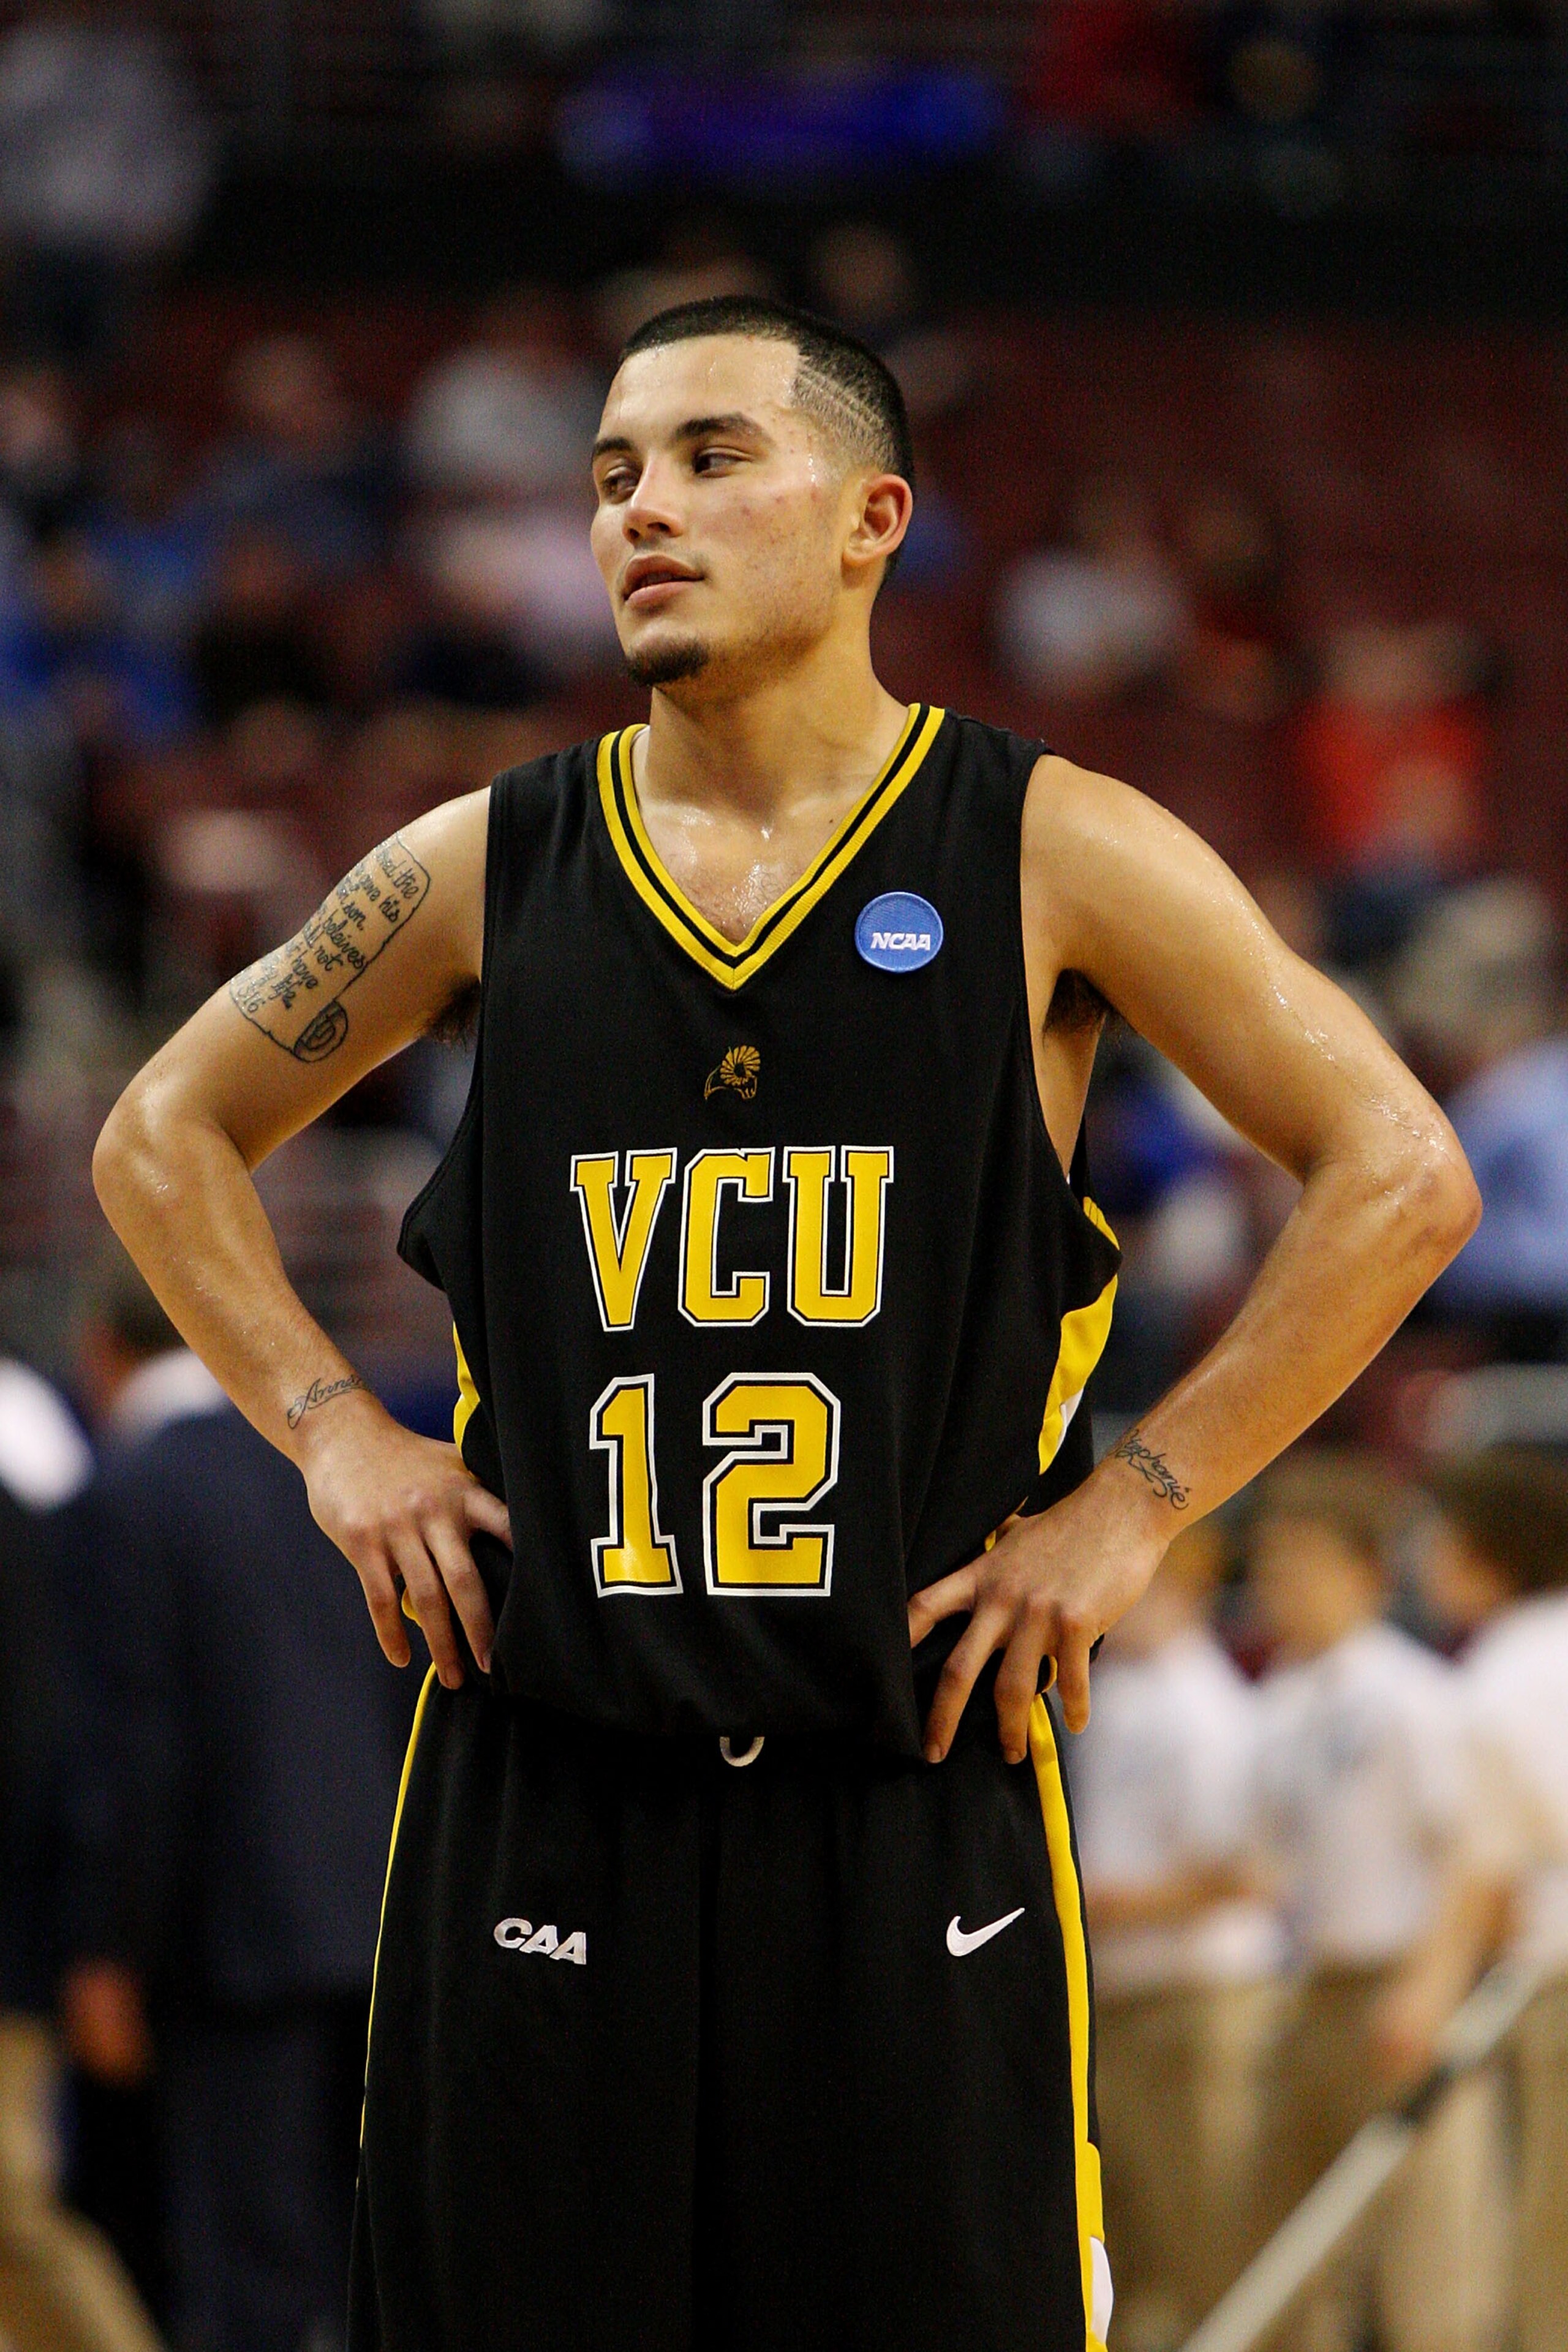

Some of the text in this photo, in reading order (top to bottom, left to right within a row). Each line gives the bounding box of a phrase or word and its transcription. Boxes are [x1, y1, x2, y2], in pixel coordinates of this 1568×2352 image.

[393, 868, 419, 899] the
[379, 894, 400, 922] his
[314, 944, 344, 971] not
[870, 932, 931, 951] NCAA
[291, 949, 318, 989] have
[570, 1146, 895, 1332] VCU
[589, 1372, 842, 1598] 12
[493, 1917, 587, 1966] CAA
